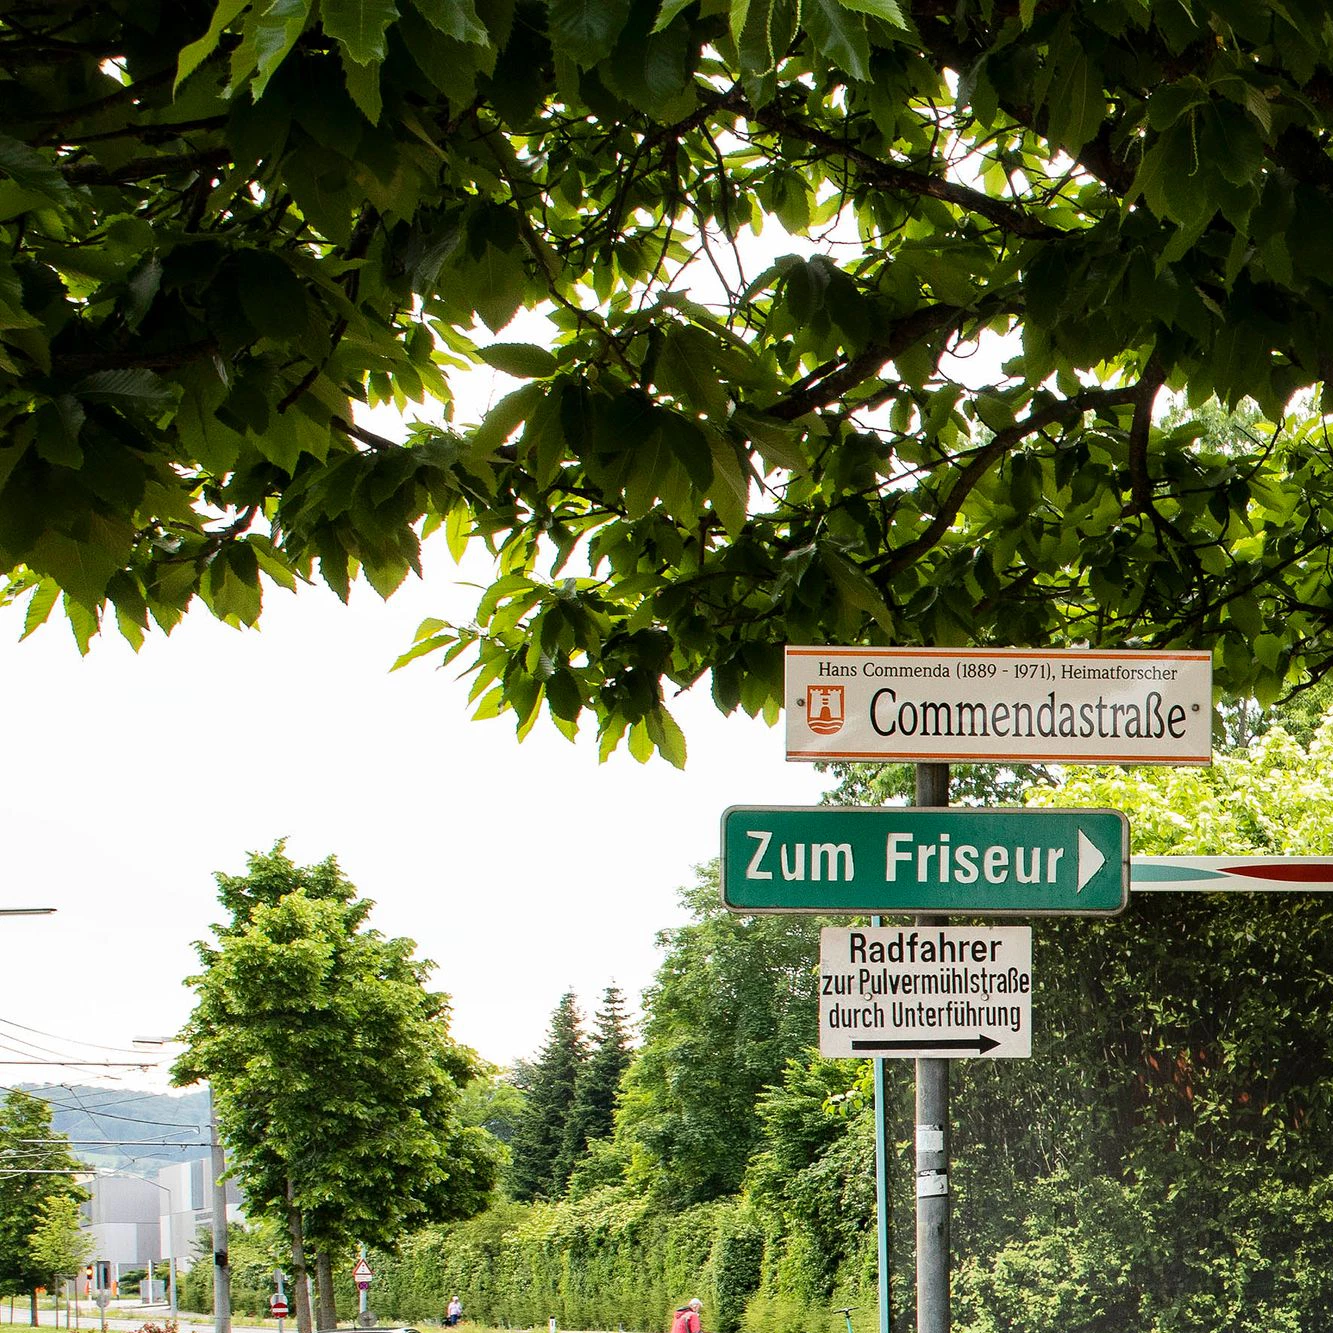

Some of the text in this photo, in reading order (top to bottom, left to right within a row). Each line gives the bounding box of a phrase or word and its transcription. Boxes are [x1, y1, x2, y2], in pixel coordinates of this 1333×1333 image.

[819, 661, 857, 677] Hans
[863, 662, 950, 678] Commenda
[956, 661, 997, 680] (1889
[1014, 662, 1056, 682] 1971),
[1061, 663, 1178, 681] Heimatforscher
[870, 687, 1187, 739] Commendastraße
[745, 829, 1065, 884] Zum Friseur
[850, 931, 1003, 963] Radfahrer
[822, 967, 1030, 996] zur Pulvermühlstraße
[829, 1000, 1021, 1032] durch Unterführung
